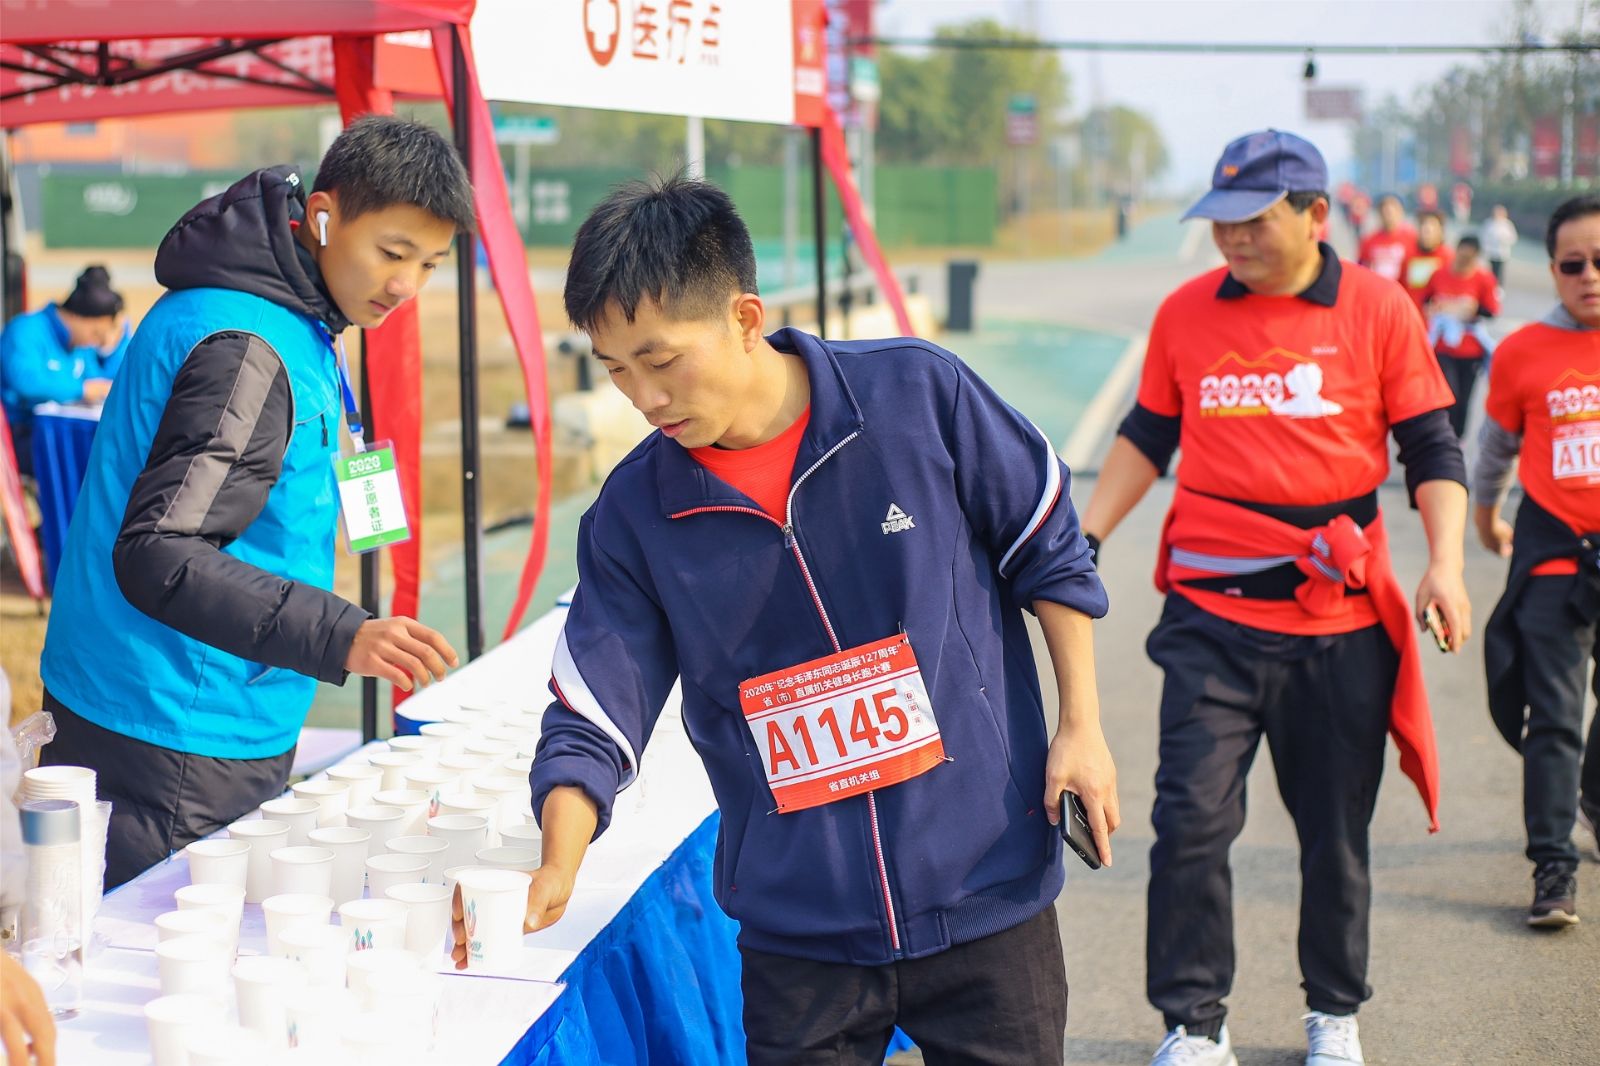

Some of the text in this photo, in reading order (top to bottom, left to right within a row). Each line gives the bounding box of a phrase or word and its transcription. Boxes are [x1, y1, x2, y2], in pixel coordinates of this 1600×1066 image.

[632, 0, 721, 65] 医疗点
[1200, 373, 1285, 408] 2020
[362, 479, 383, 532] 志愿者证
[767, 687, 910, 776] A1145
[828, 769, 881, 793] 省直机关组
